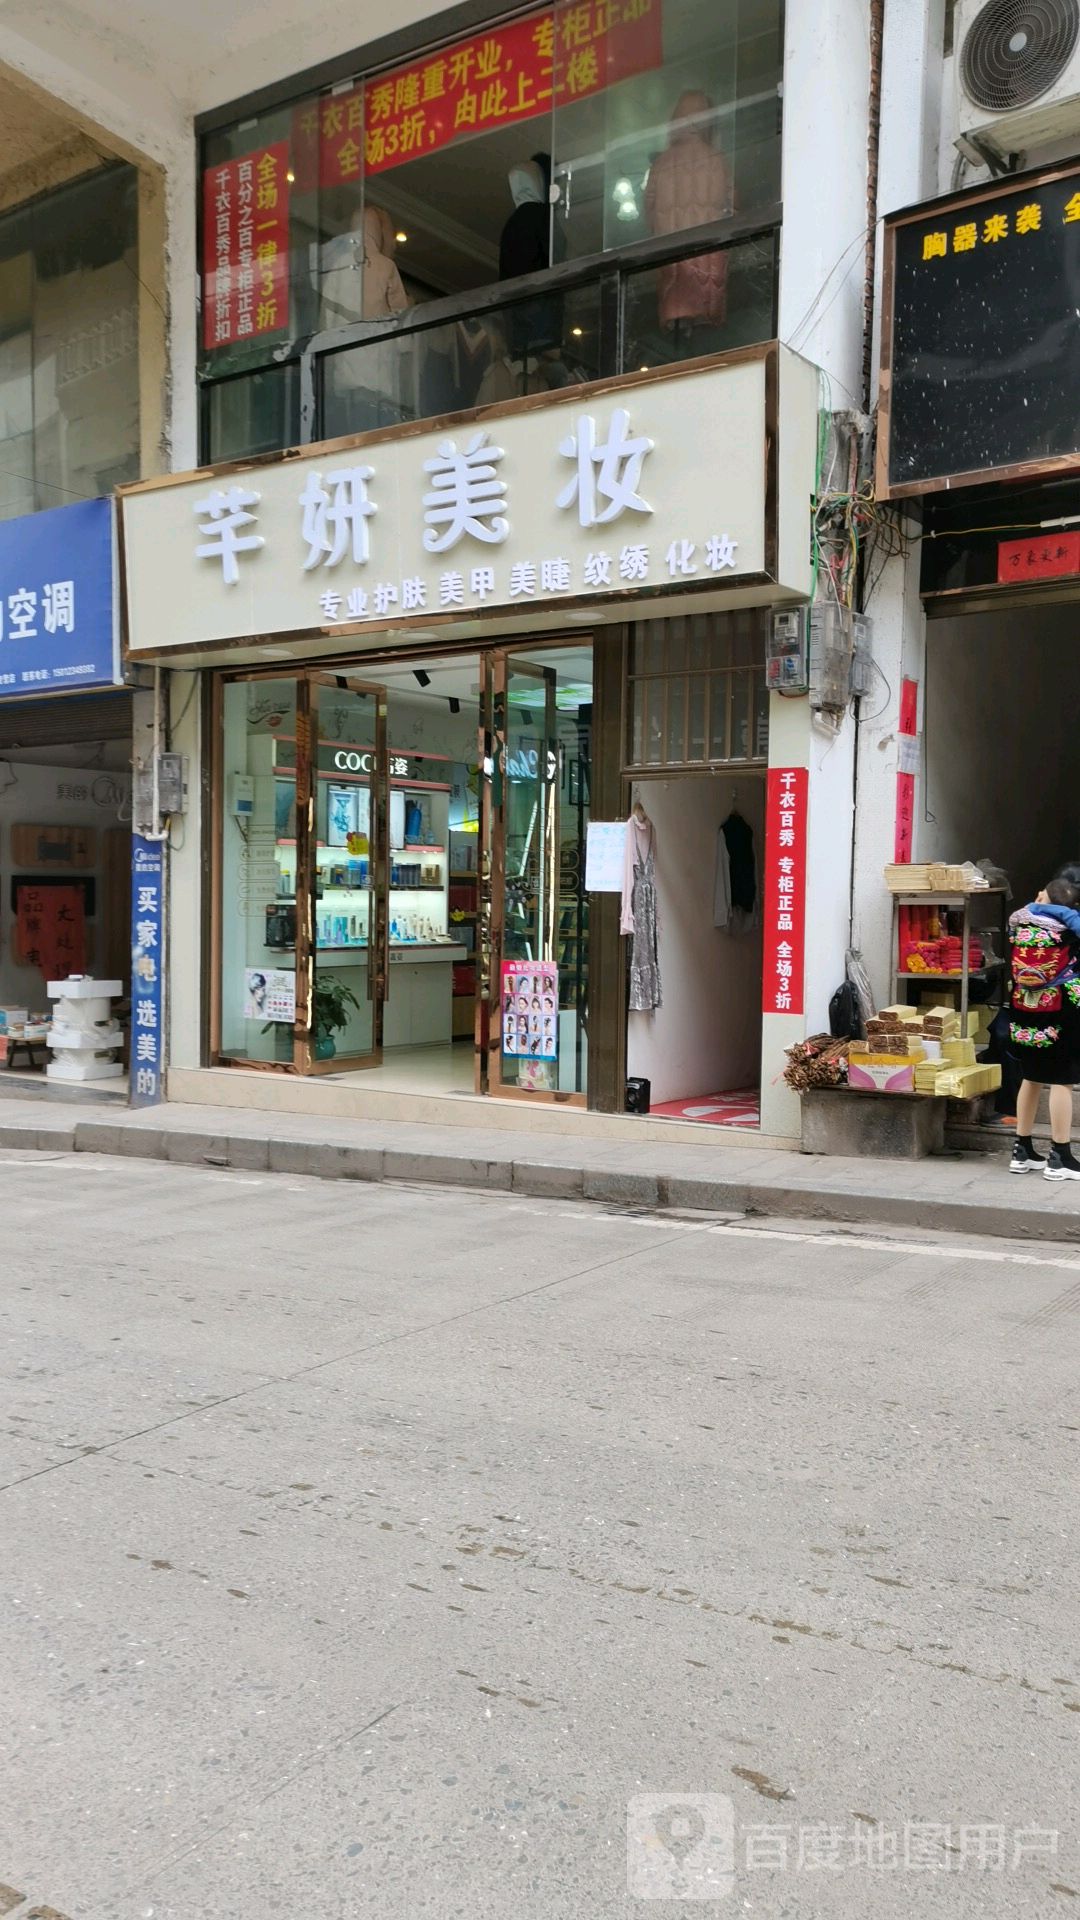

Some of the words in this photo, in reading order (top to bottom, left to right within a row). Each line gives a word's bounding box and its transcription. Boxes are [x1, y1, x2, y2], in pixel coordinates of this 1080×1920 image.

[237, 159, 254, 336] 百分之百专柜正品
[256, 152, 278, 330] 全场一律3折
[922, 203, 1042, 261] 胸器来袭
[193, 407, 656, 585] 芊妍美妆
[0, 580, 75, 642] 空调
[319, 574, 427, 620] 专业护肤
[439, 565, 497, 608] 美甲
[583, 543, 649, 586] 纹绣
[664, 533, 740, 577] 化妆
[778, 771, 796, 847] 千衣百秀
[776, 856, 795, 931] 专柜正品
[774, 940, 793, 1010] 全场3折
